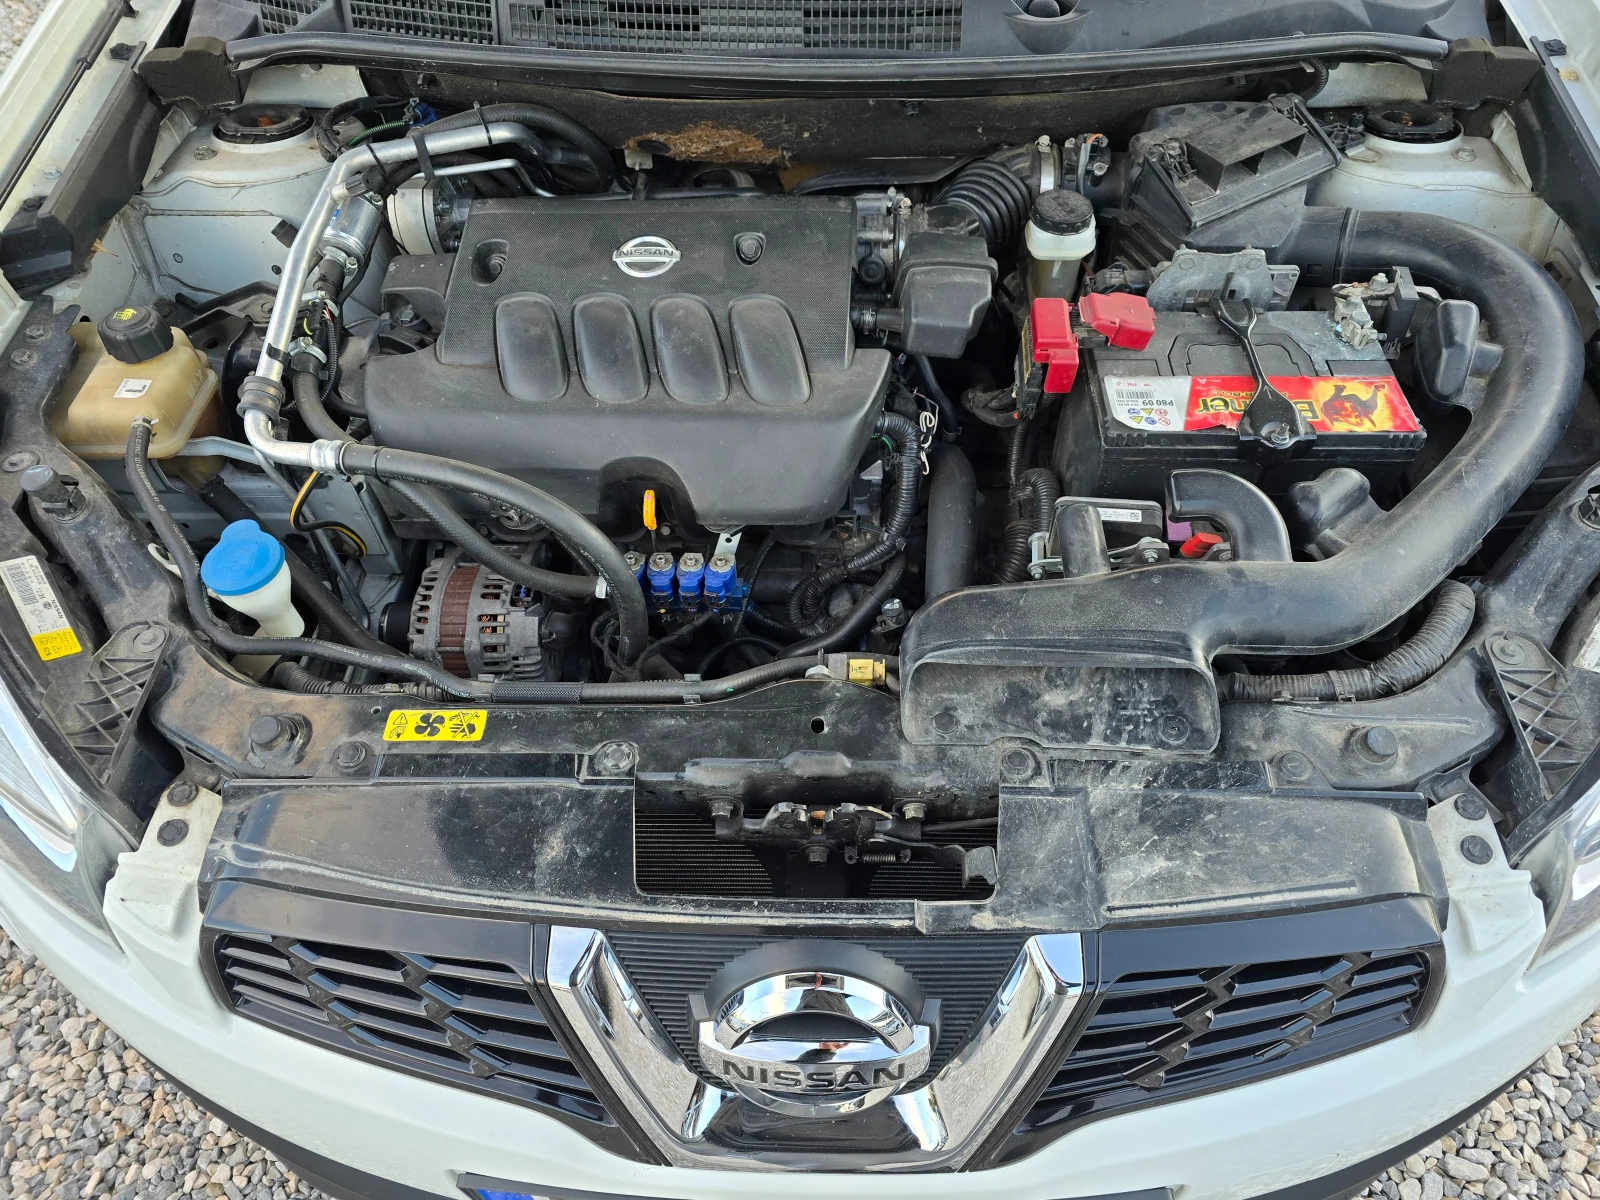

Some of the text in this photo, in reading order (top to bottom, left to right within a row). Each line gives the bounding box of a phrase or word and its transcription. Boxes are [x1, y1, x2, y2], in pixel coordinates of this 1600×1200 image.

[618, 248, 674, 257] NISSAN
[1142, 399, 1174, 407] P80 09
[1196, 398, 1319, 421] Bner
[51, 599, 64, 619] NISSAN
[722, 1059, 906, 1091] NISSAN
